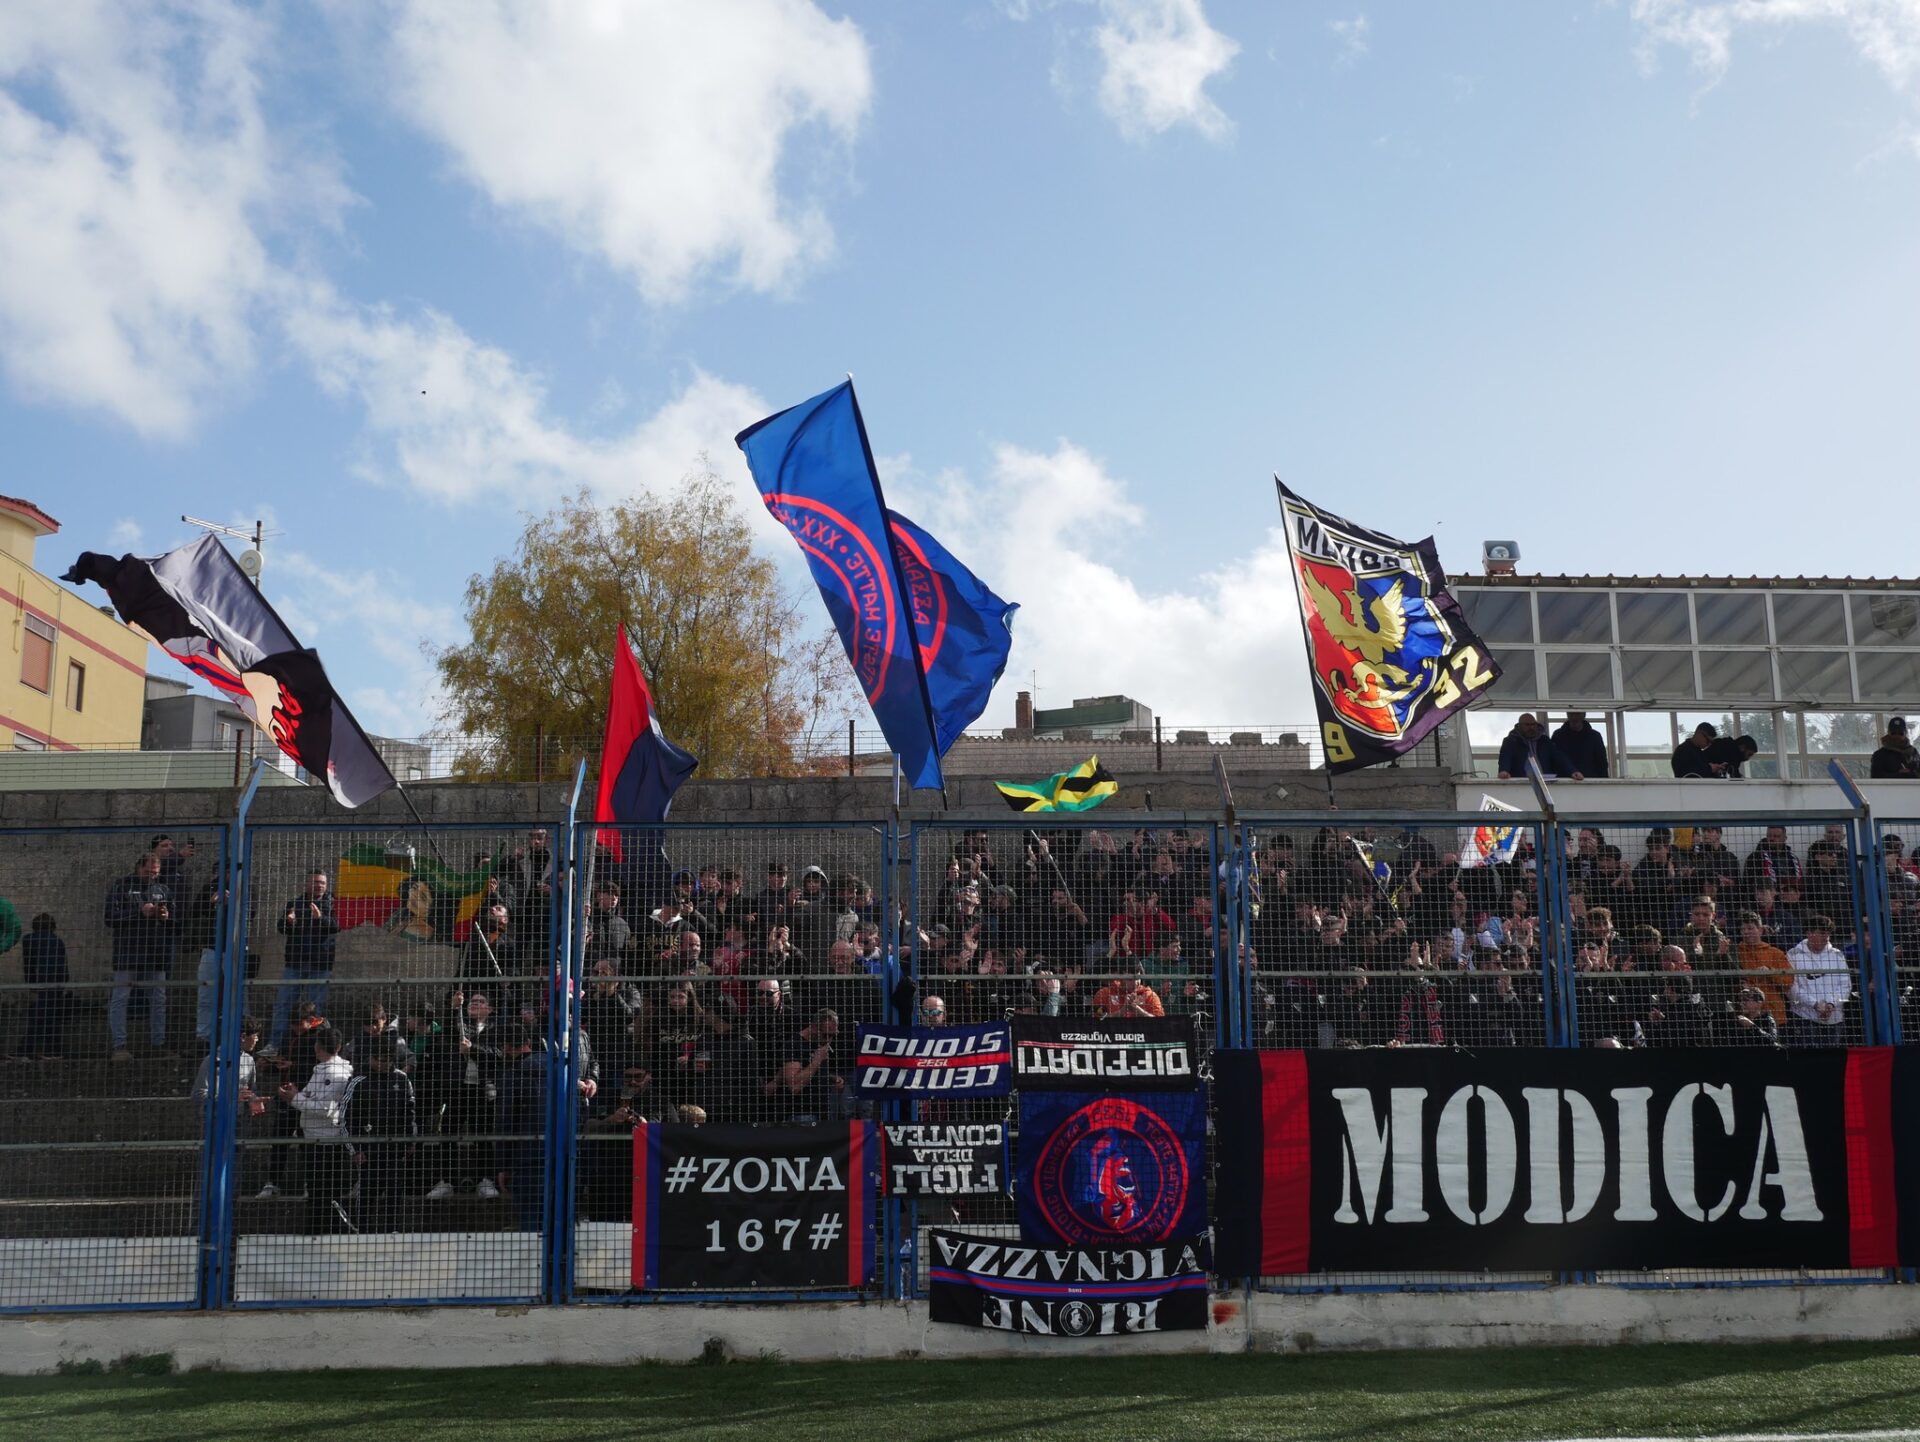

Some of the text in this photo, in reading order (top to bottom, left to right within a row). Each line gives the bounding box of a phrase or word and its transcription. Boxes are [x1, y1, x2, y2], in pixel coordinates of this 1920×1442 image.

[895, 544, 933, 626] GNAZZA
[860, 1030, 1006, 1055] STORICO
[1061, 1032, 1145, 1043] Rione Vignazza
[1017, 1046, 1191, 1076] DIFFIDATI
[860, 1064, 1000, 1090] CENTRO
[884, 1123, 1003, 1147] CONTEA
[913, 1148, 974, 1163] DELLA
[1331, 1082, 1825, 1226] MODICA
[664, 1156, 846, 1193] #ZONA
[891, 1164, 999, 1194] FIGLI
[931, 1235, 1203, 1282] VIGNAZZA
